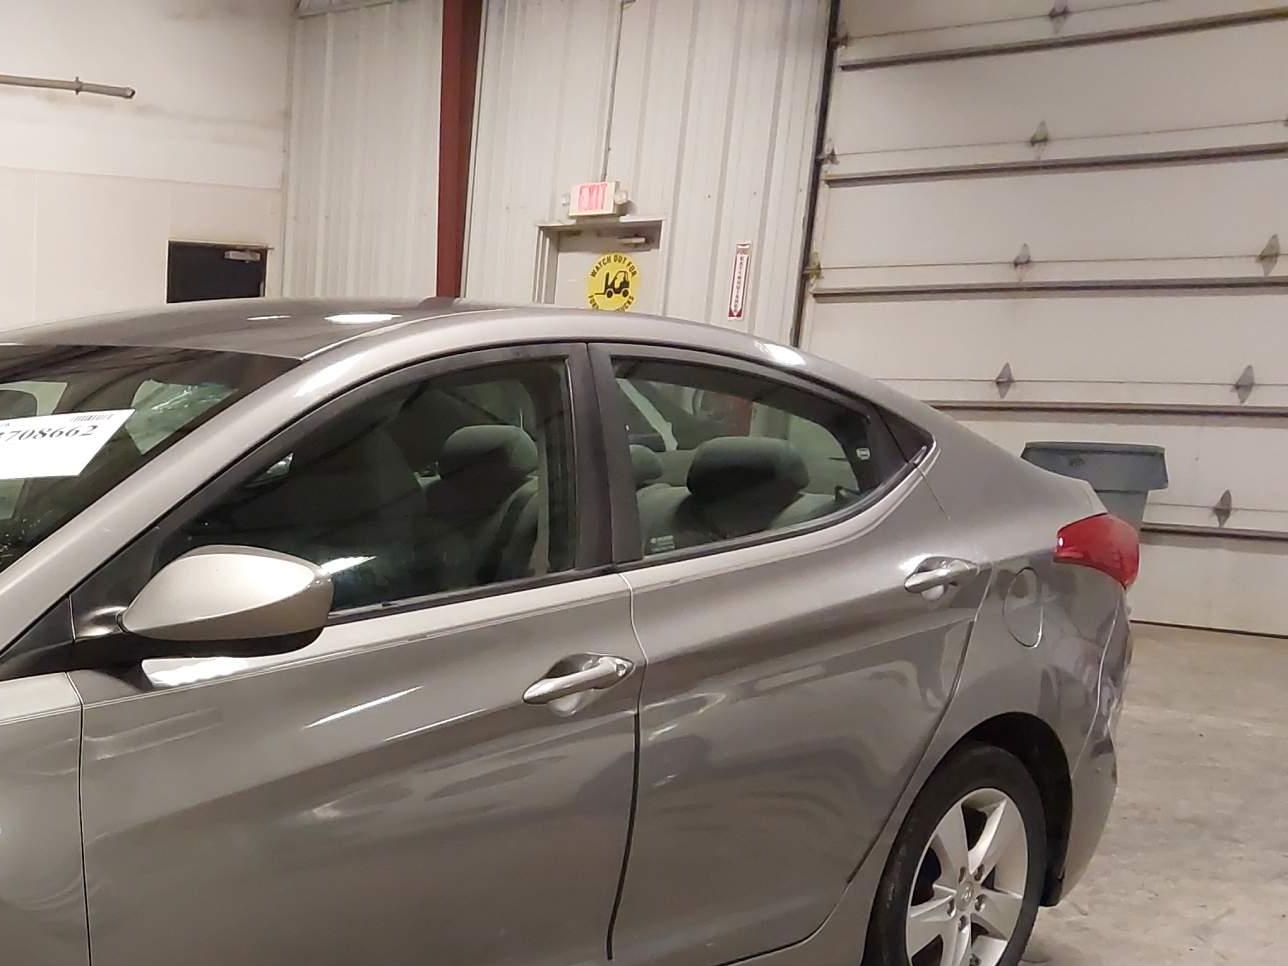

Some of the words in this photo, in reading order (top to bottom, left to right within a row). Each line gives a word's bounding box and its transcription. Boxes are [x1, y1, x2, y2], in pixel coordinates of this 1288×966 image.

[578, 183, 608, 211] EXIT
[590, 255, 612, 277] WATCH
[613, 254, 627, 264] OUT
[626, 261, 638, 277] FOR
